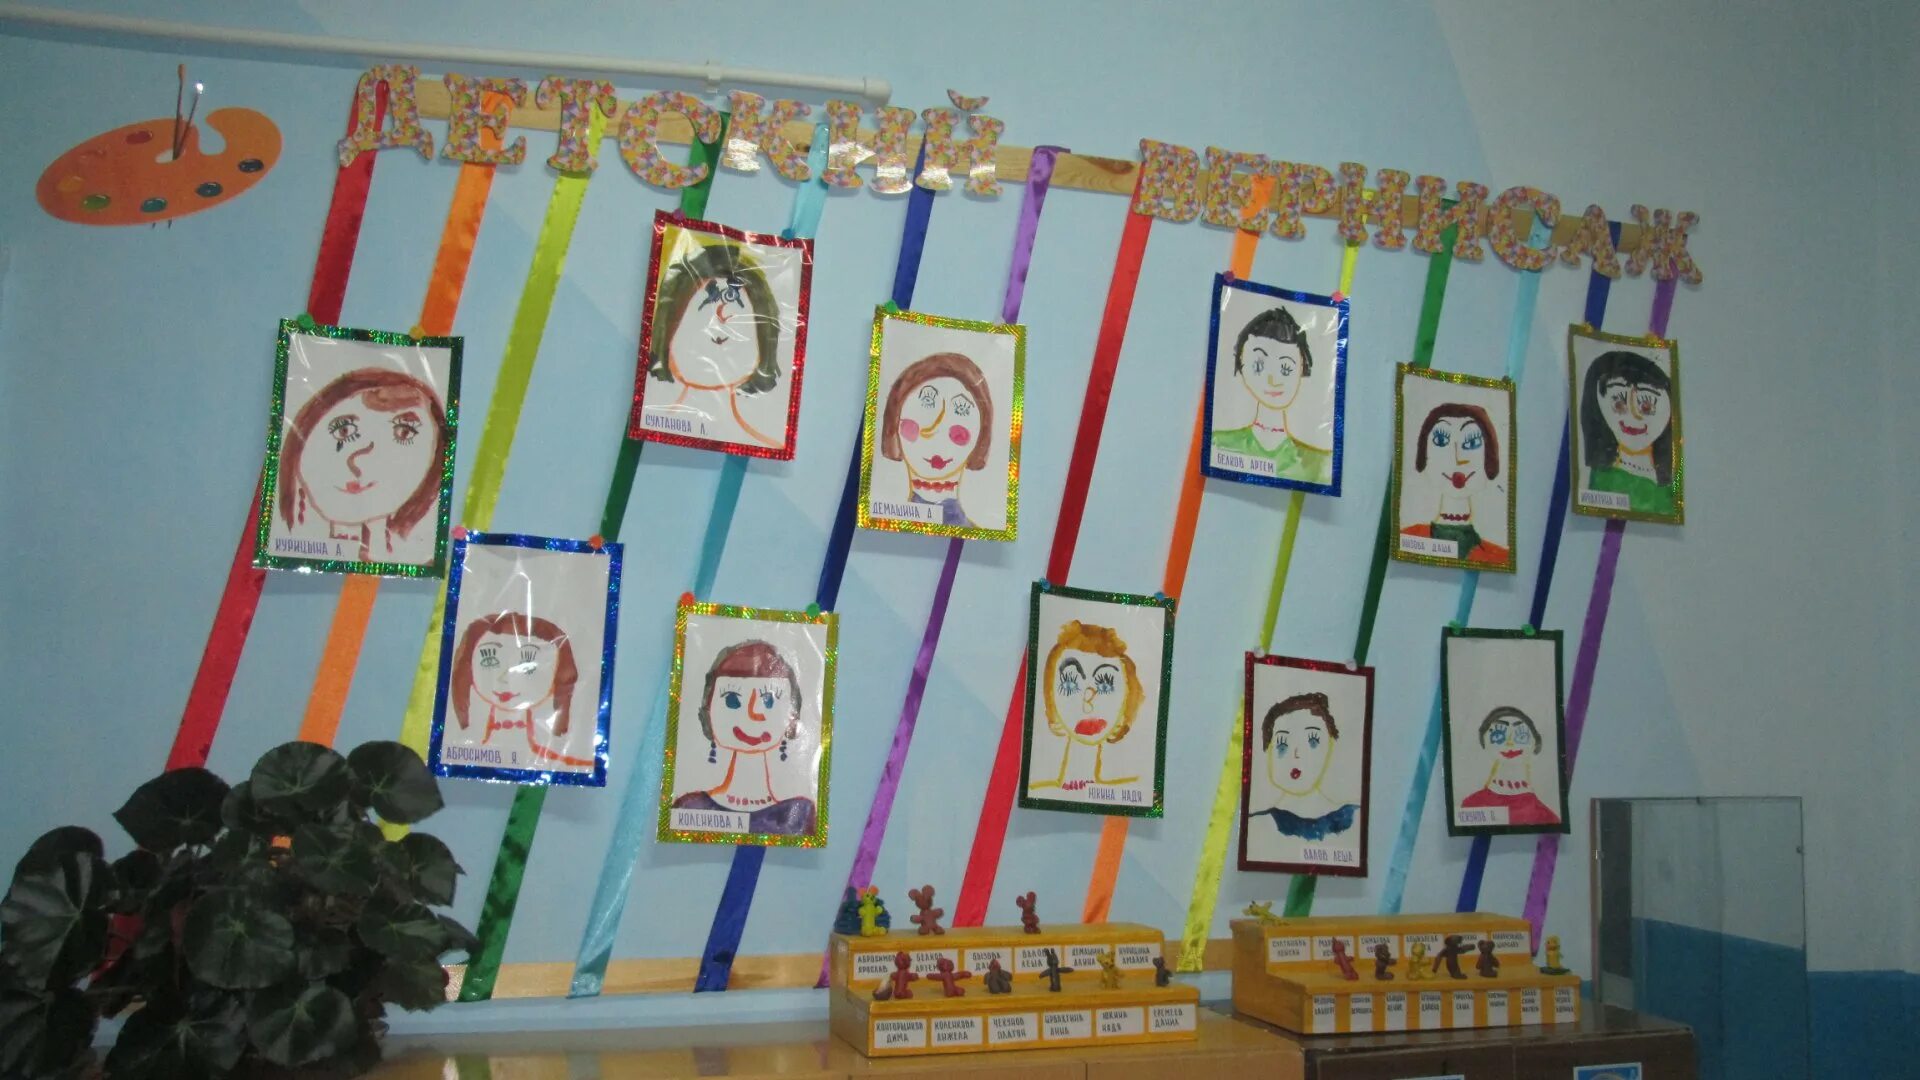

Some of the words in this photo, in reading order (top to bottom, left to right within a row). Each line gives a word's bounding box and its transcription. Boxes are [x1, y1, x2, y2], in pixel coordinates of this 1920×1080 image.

[337, 64, 1004, 195] ДЕТСКИЙ
[1132, 138, 1702, 284] ВЕРНИСАЖ
[645, 414, 692, 433] СУЛТАНОВА
[1250, 458, 1274, 473] АРТЕМ
[872, 501, 920, 518] ДЕМАШИНА
[275, 537, 328, 555] КУРИЦЫНА
[446, 746, 502, 764] АБРОСИМОВ
[1088, 786, 1115, 801] ЮКИНА
[1121, 788, 1142, 803] НАДЯ
[678, 812, 732, 829] КОЛЕНКОВА
[886, 1033, 909, 1043] ДИМА
